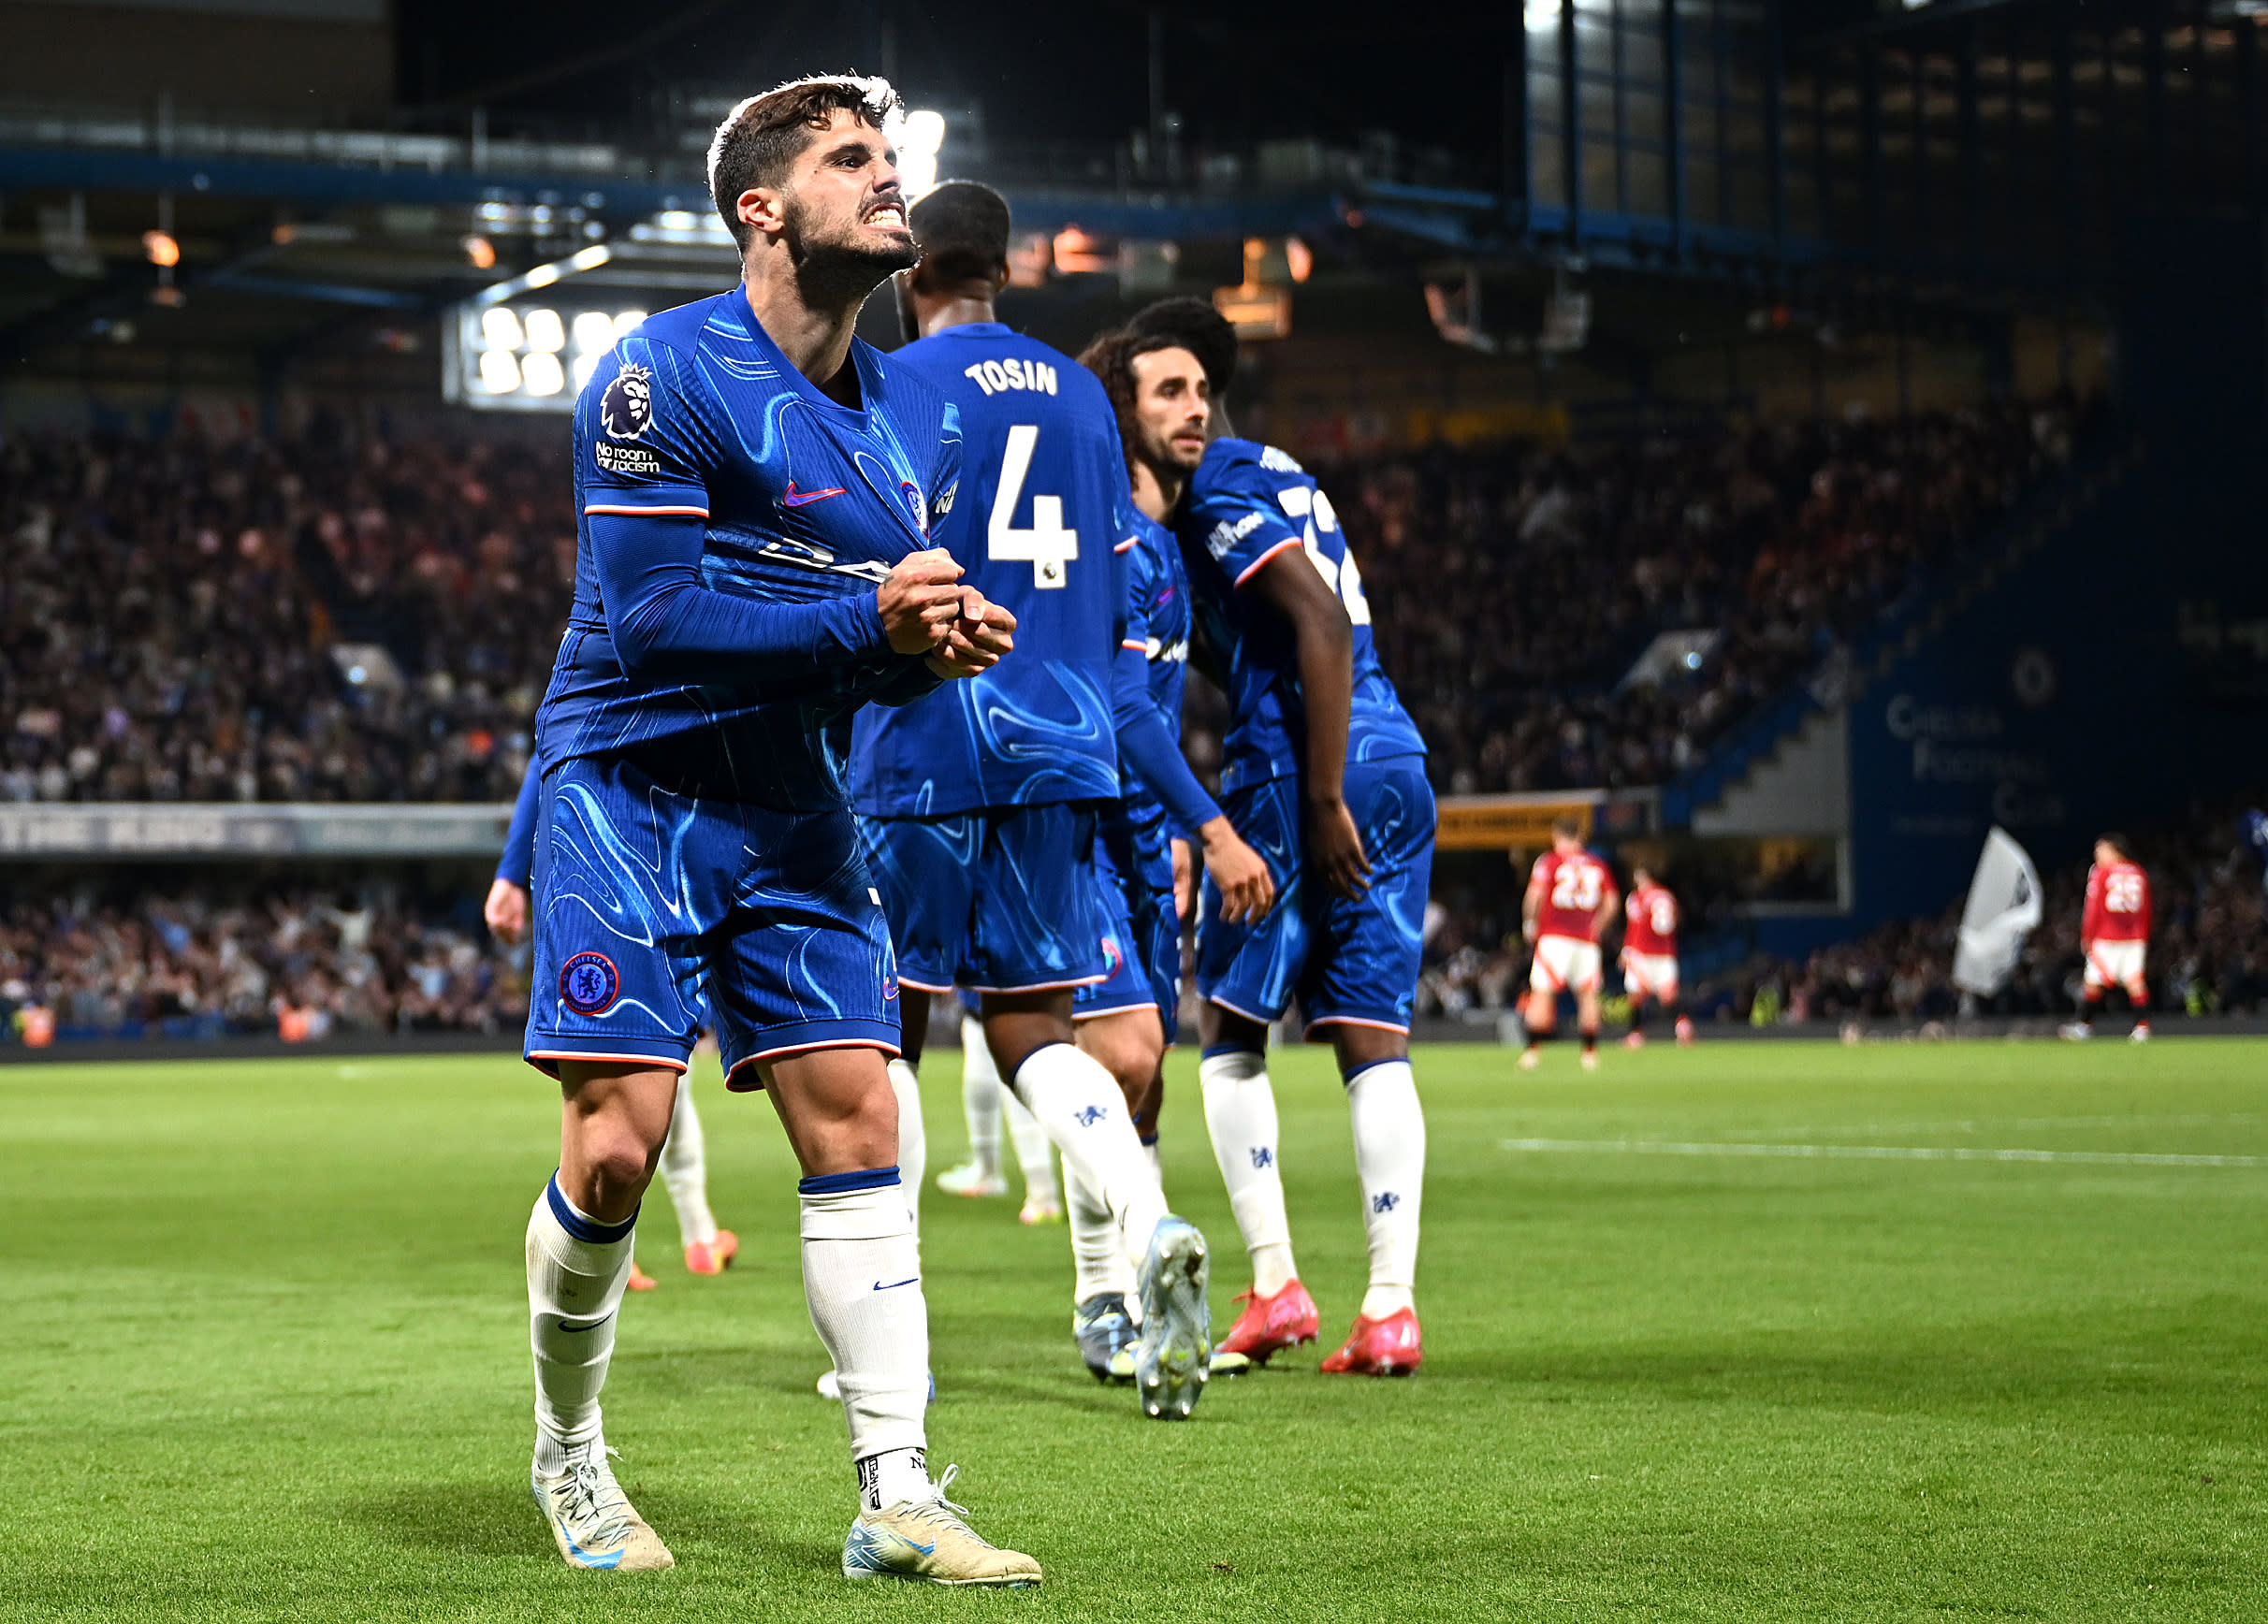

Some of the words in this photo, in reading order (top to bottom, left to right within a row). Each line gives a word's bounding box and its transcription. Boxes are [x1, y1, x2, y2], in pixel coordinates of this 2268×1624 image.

[965, 358, 1057, 396] TOSIN
[596, 442, 613, 457] No
[614, 448, 653, 461] room
[613, 459, 661, 472] racism
[988, 425, 1078, 588] 4
[1551, 862, 1605, 910] 23
[570, 955, 606, 969] CHELSEA
